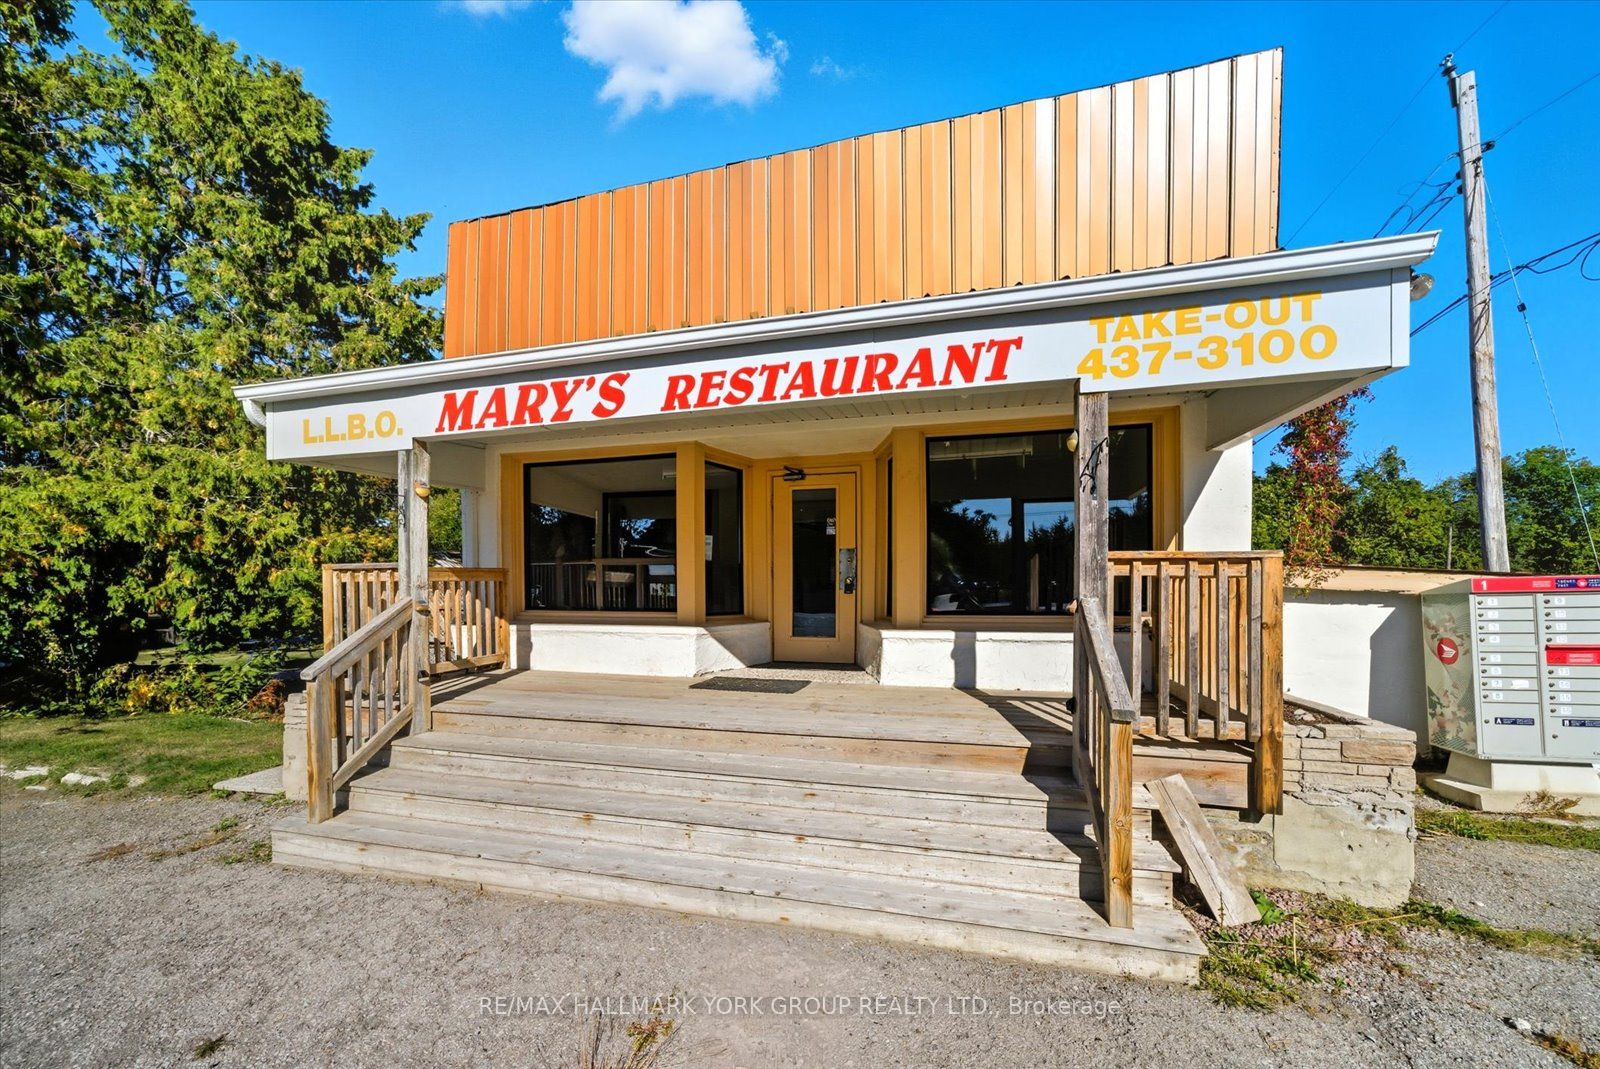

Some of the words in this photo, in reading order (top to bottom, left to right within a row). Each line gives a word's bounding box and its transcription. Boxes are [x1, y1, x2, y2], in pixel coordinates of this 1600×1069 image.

[1088, 290, 1323, 344] TAKE-OUT
[1076, 324, 1338, 381] 437-3100
[436, 373, 629, 433] MARY'S
[662, 337, 1023, 412] RESTAURANT
[303, 411, 404, 445] L.L.B.O.
